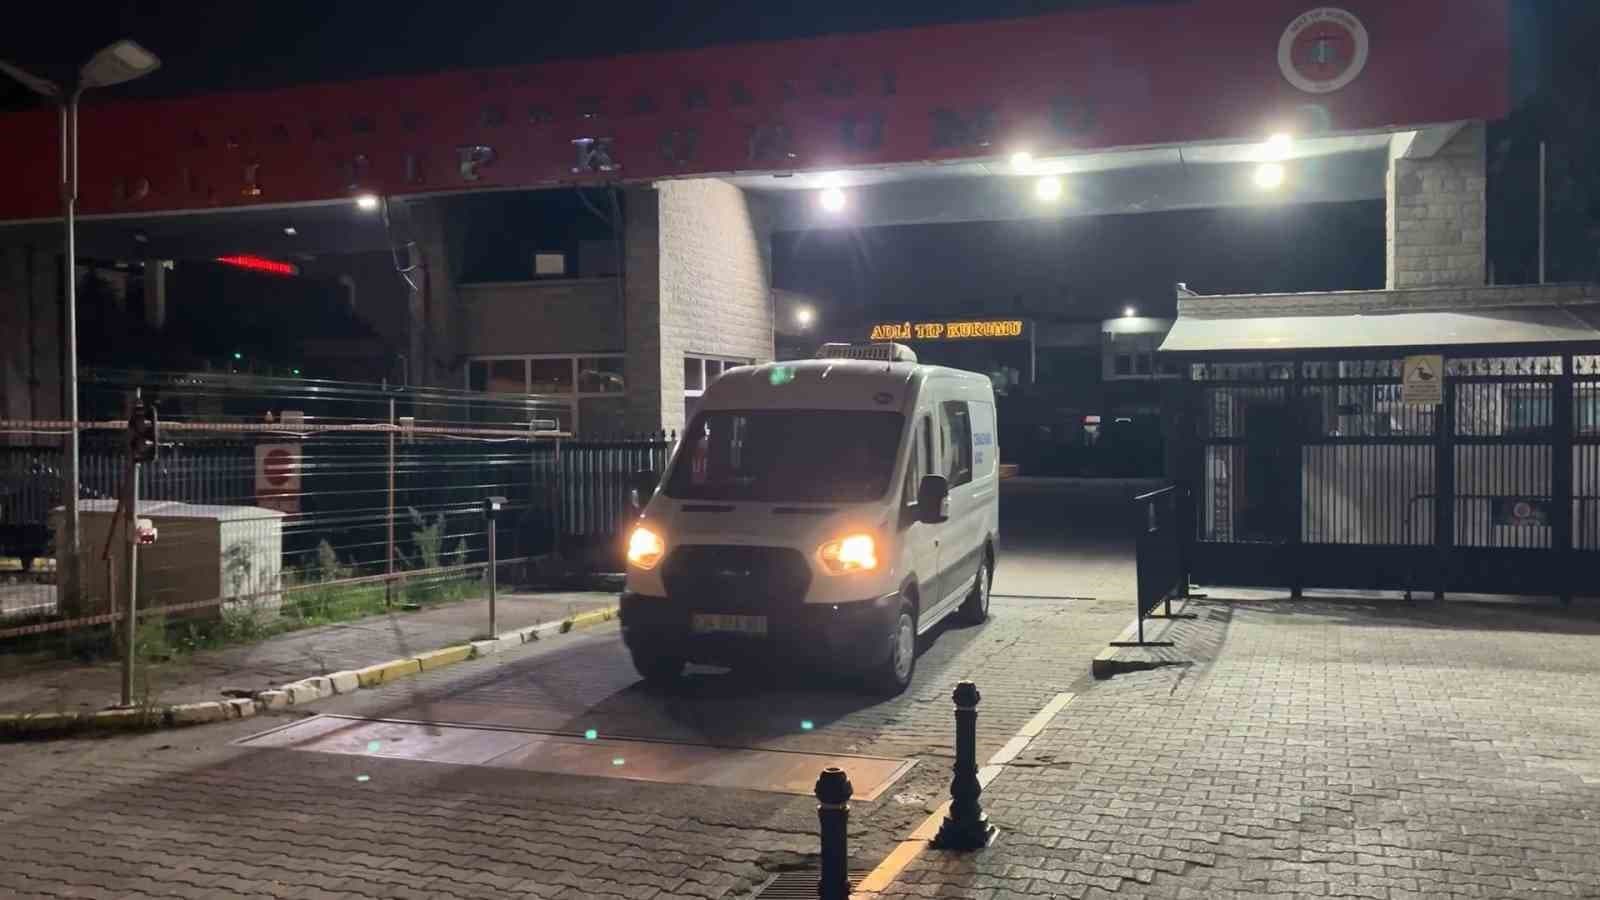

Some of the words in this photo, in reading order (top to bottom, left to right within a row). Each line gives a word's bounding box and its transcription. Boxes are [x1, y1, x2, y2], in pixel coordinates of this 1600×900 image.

[871, 321, 911, 339] ADLİ
[915, 322, 944, 338] TIP
[947, 320, 1022, 337] KURUMU
